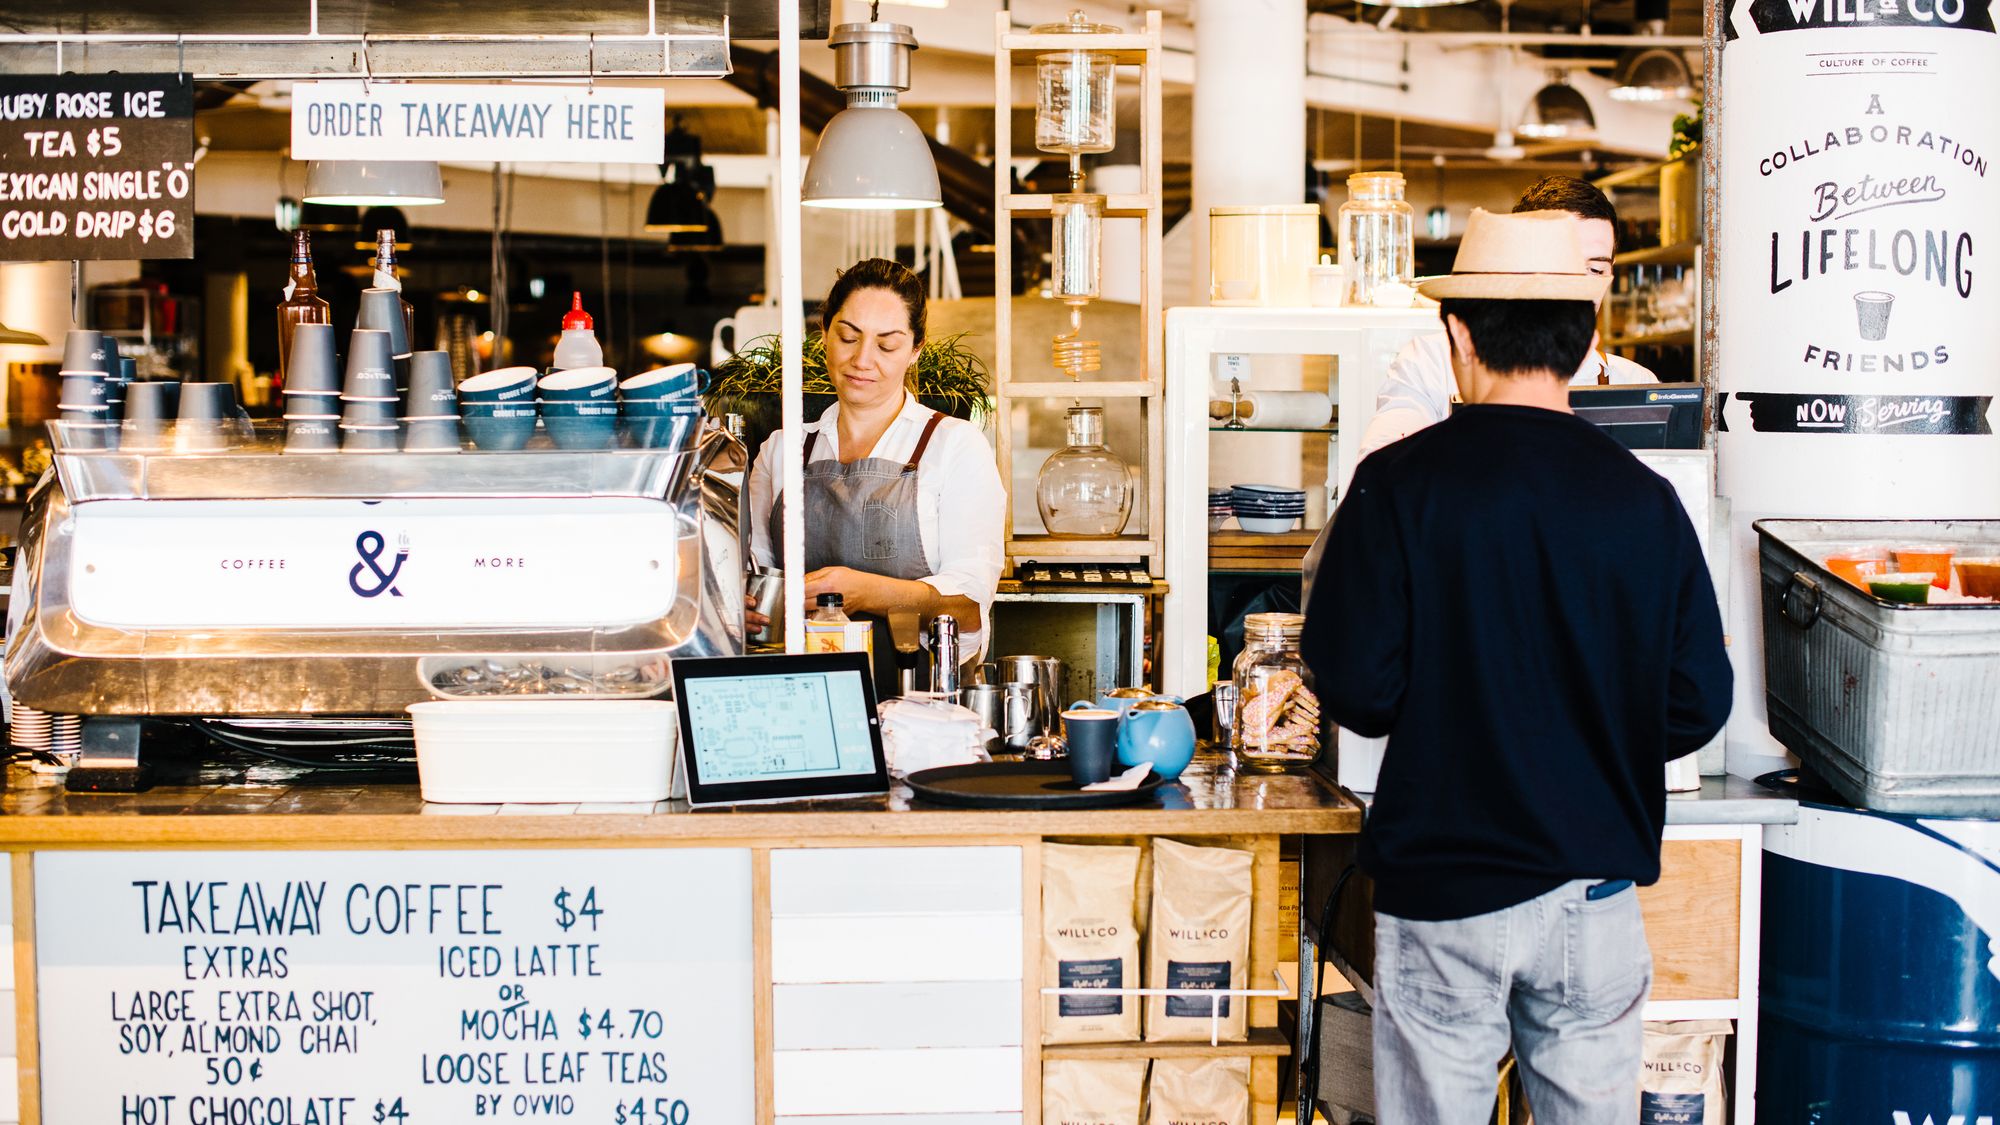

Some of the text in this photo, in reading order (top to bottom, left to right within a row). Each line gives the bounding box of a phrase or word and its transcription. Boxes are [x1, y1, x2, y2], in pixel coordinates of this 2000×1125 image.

[1819, 57, 1929, 68] CULTURE OF COFFEE
[0, 91, 166, 121] UBY ROSE ICE
[1865, 94, 1886, 114] A
[308, 102, 635, 141] ORDER TAKEAWAY HERE
[23, 126, 122, 158] TEA $5
[1759, 125, 1988, 178] COLLABORATION
[82, 170, 162, 201] SINGLE
[1809, 174, 1946, 222] Between
[2, 208, 176, 244] COLD DRIP $6
[1771, 228, 1973, 298] LIFELONG
[1803, 344, 1950, 372] FRIENDS
[1796, 398, 1951, 427] NOW Serving
[221, 559, 286, 569] COFFEE
[474, 557, 526, 568] MORE
[132, 880, 604, 936] TAKEAWAY COFFEE $4
[183, 945, 288, 980] EXTRAS
[439, 944, 602, 978] ICED LATTE
[111, 990, 378, 1026] LARGE, EXTRA SHOT,
[499, 984, 526, 1001] OR
[461, 1007, 663, 1041] MOCHA $4.70
[119, 1024, 358, 1058] SOY, ALMOND CHAI
[422, 1051, 669, 1085] LOOSE LEAF TEAS
[121, 1095, 410, 1125] HOT CHOCOLATE $4
[476, 1094, 574, 1116] BY OVVIO
[615, 1096, 690, 1125] $4.50
